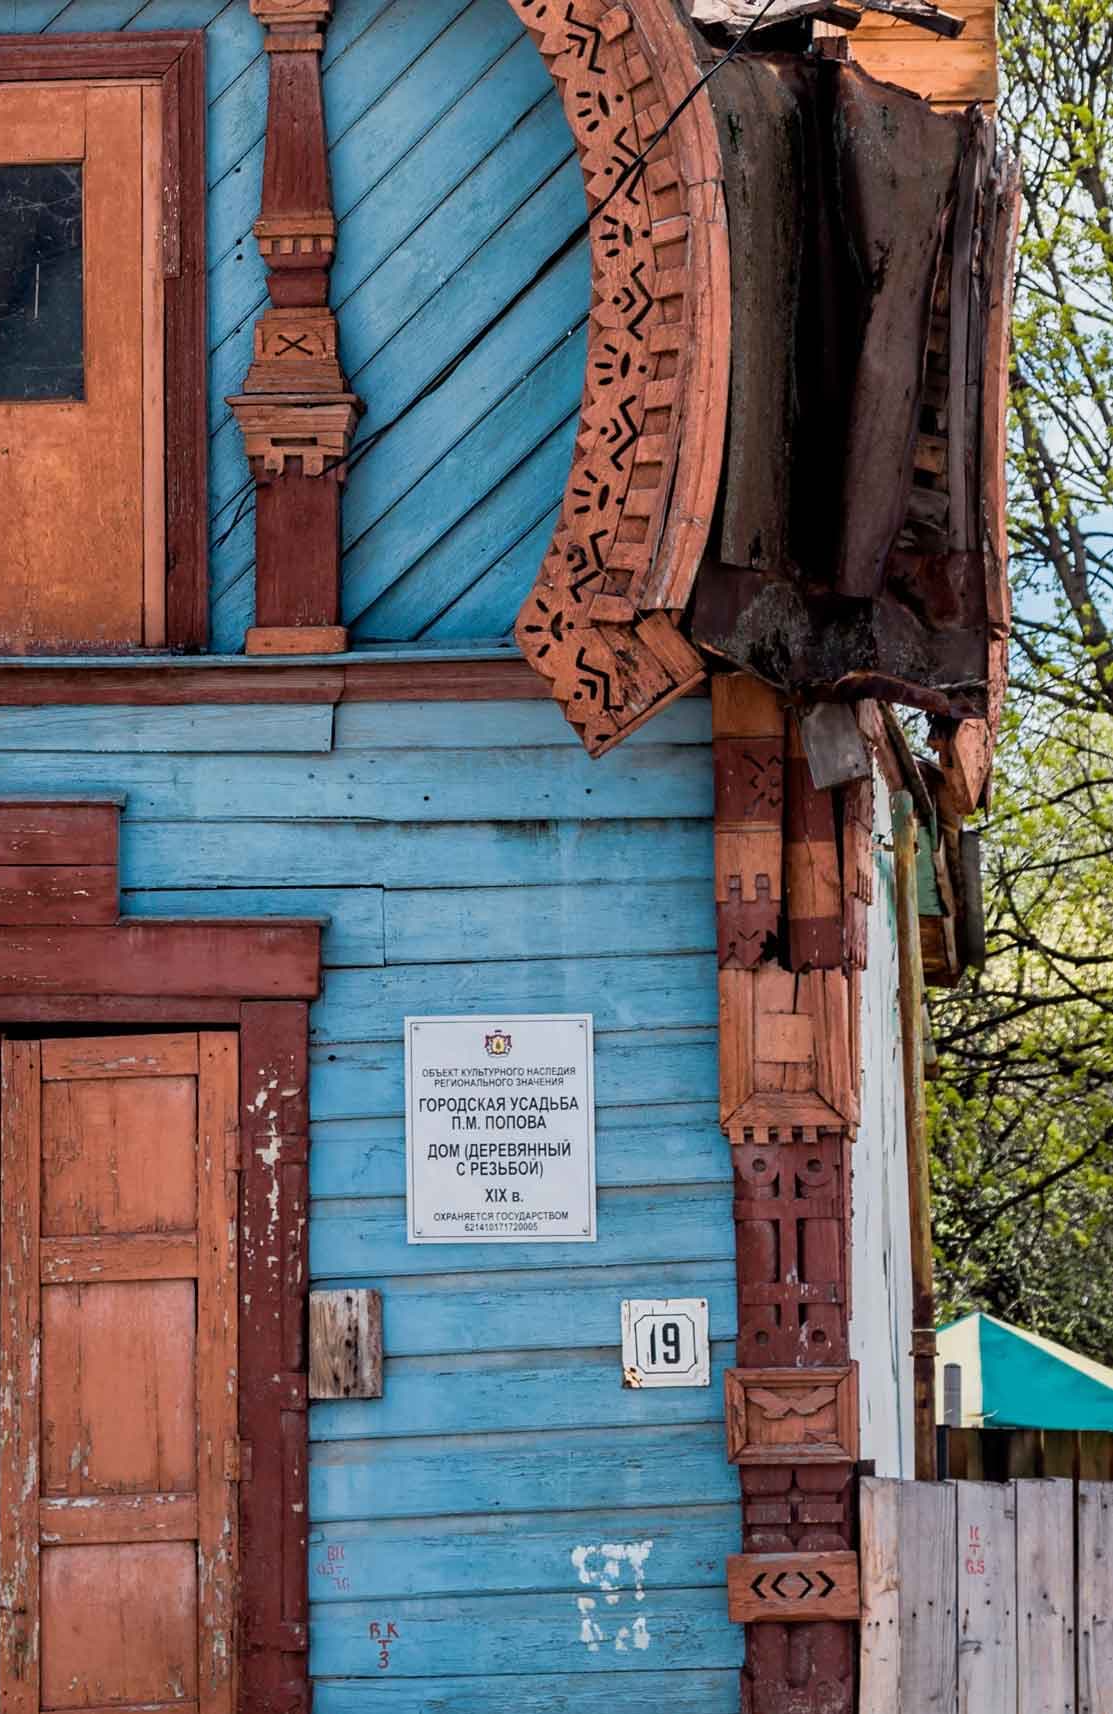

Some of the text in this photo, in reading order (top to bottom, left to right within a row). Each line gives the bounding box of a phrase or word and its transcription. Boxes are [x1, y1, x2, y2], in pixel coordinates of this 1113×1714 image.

[422, 1066, 576, 1078] ОБЪЕКТ КУЛЬТУРНОГО НАСЛЕДИЯ
[434, 1077, 564, 1088] РЕГИОНАЛЬНОГО ЗНАЧЕНИЯ
[419, 1096, 579, 1114] ГОРОДСКАЯ УСАДЬБА
[452, 1115, 547, 1130] П.М. ПОПОВА
[427, 1139, 572, 1161] ДОМ (ДЕРЕВЯННЫЙ
[456, 1157, 544, 1179] С РЕЗЬБОЙ)
[433, 1211, 569, 1222] ОХРАНЯЕТСЯ ГОСУДАРСТВОМ
[650, 1322, 681, 1366] 19
